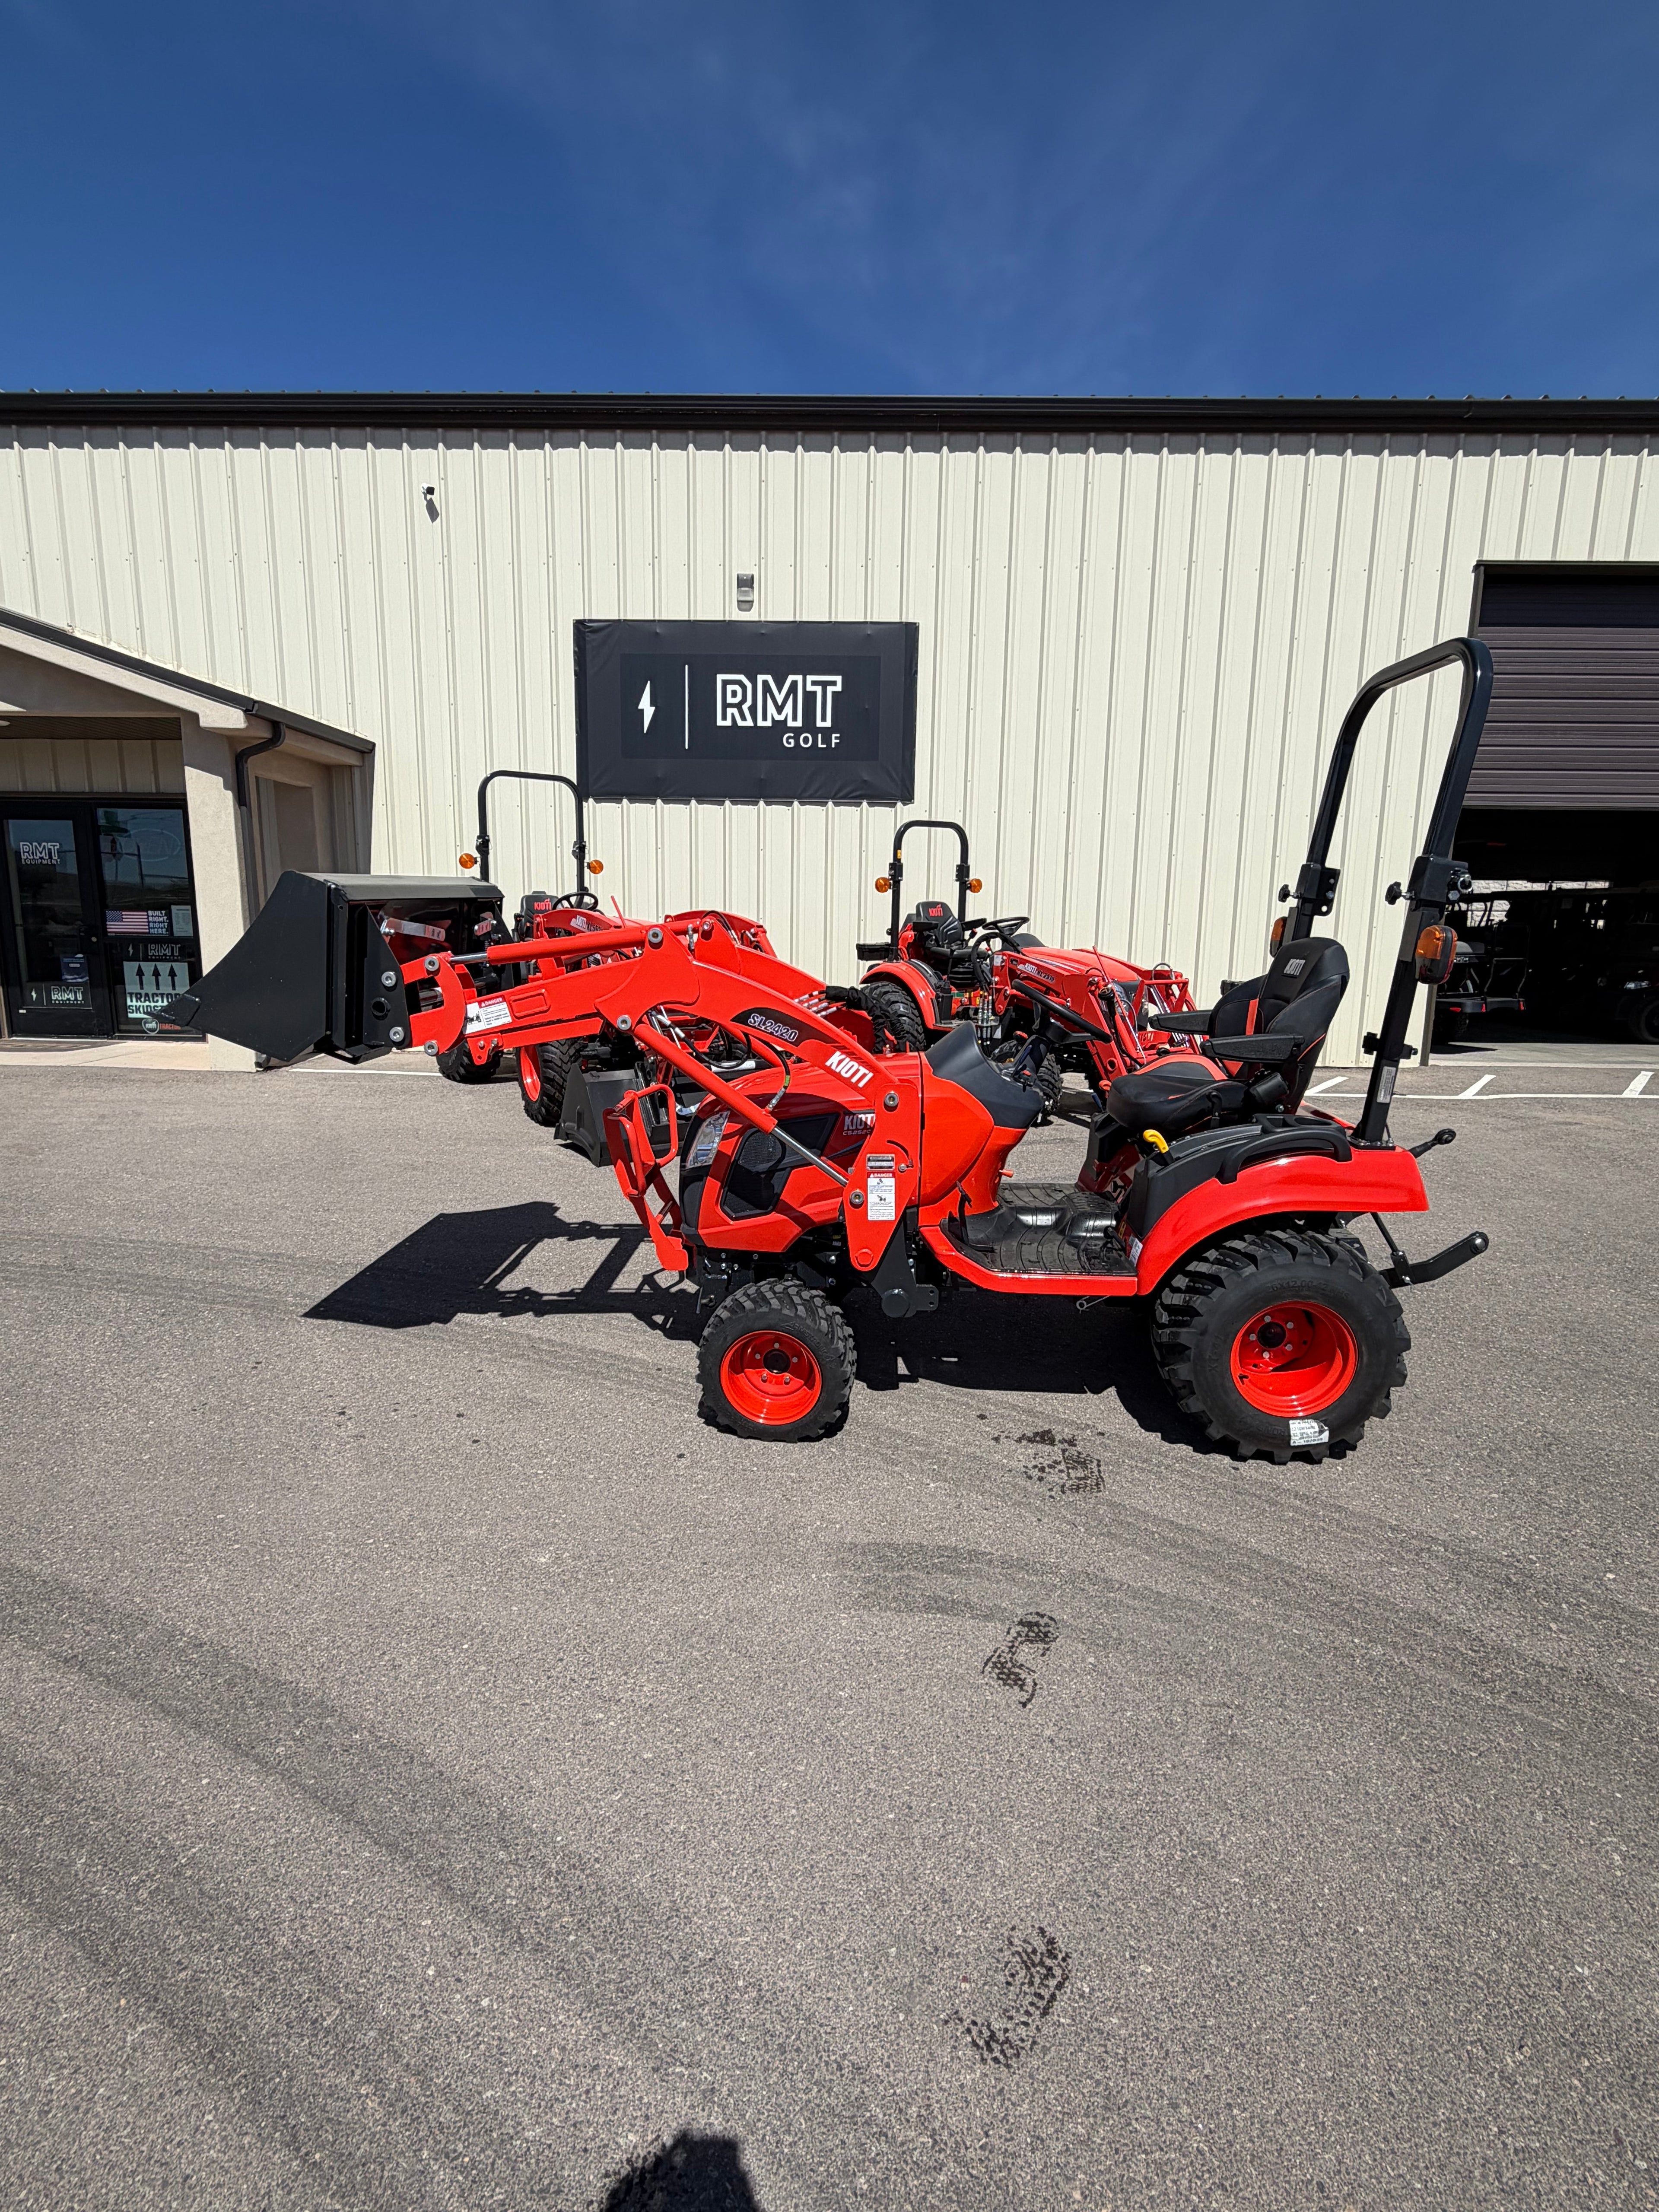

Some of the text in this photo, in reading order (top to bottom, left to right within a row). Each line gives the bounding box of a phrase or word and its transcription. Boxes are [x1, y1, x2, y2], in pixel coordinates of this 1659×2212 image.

[716, 674, 842, 727] RMT
[782, 733, 841, 748] GOLF
[20, 842, 60, 859] RMT
[534, 899, 552, 910] KIOTI
[148, 943, 181, 956] RMT
[1284, 958, 1306, 976] KIOTI
[51, 986, 83, 1000] RMT
[485, 997, 503, 1006] DANGER
[748, 1014, 798, 1042] SL2420
[825, 1050, 874, 1088] KIOTI
